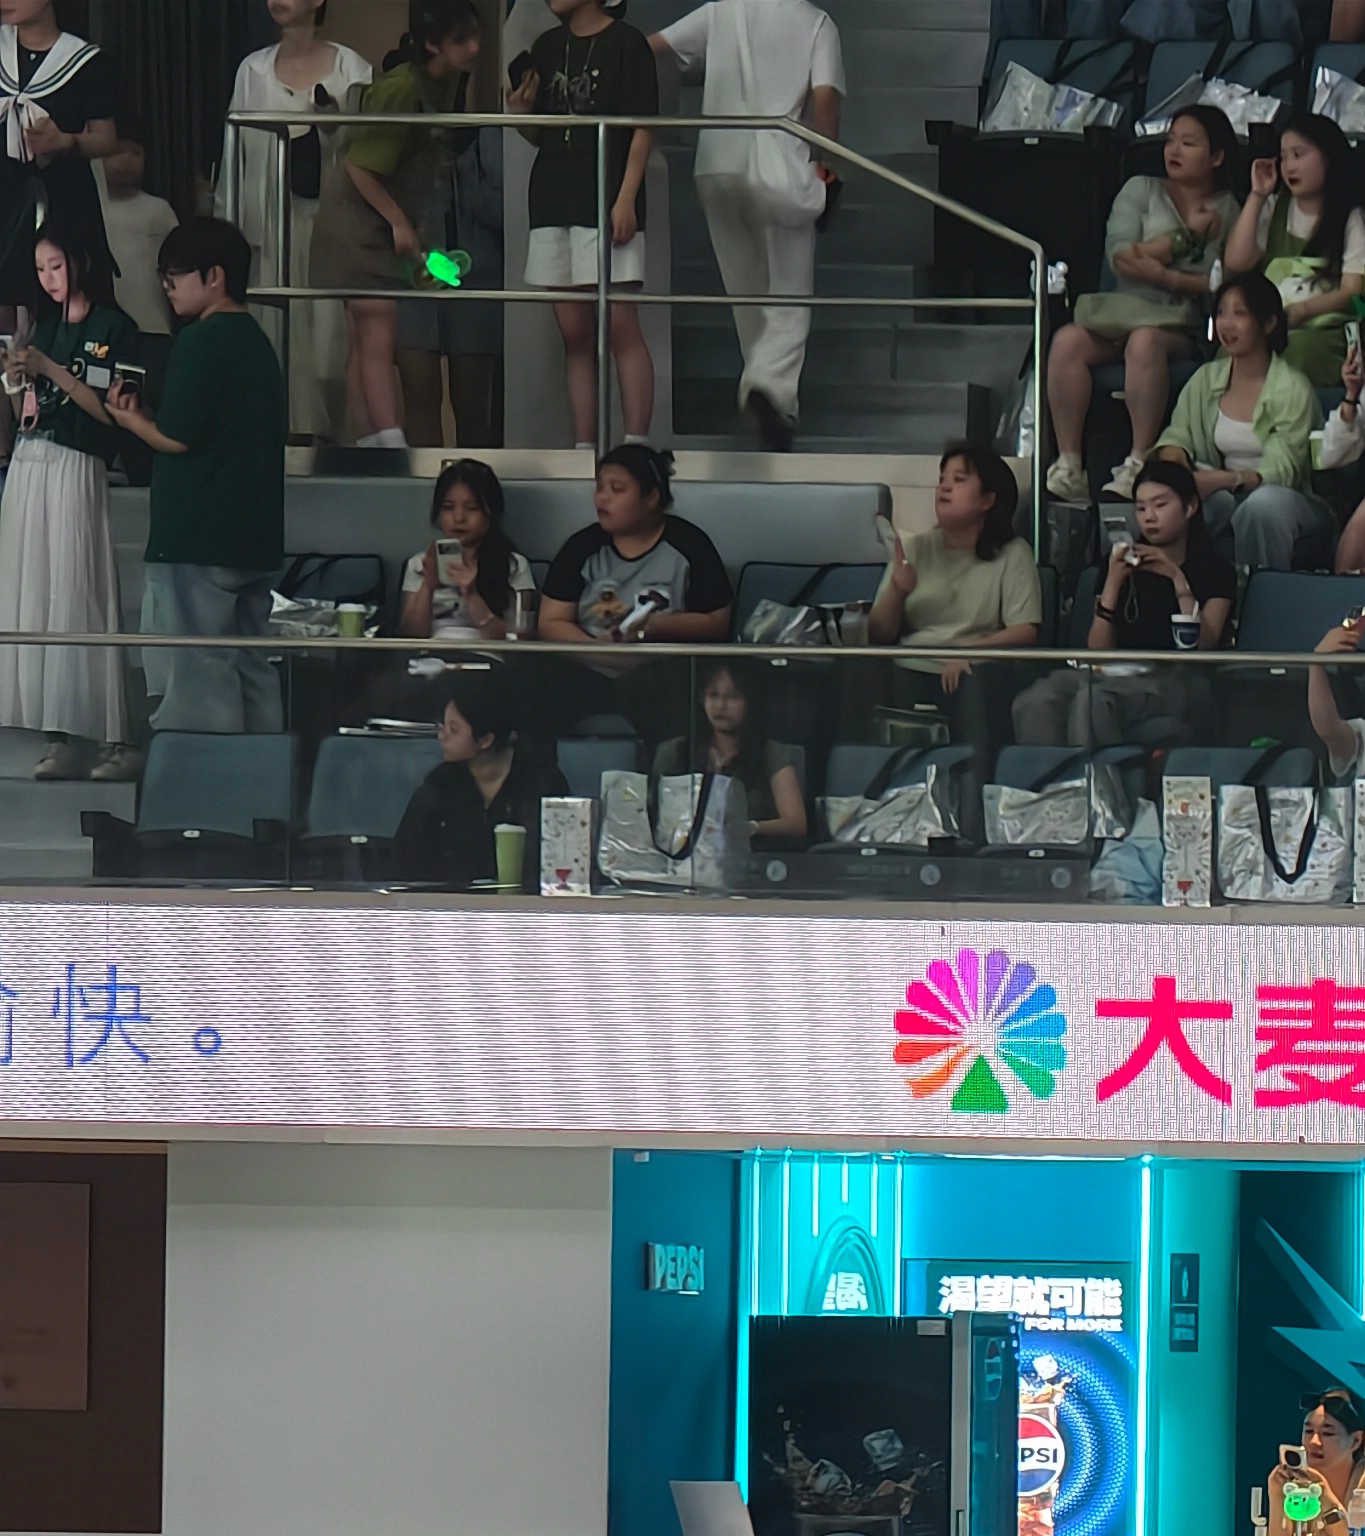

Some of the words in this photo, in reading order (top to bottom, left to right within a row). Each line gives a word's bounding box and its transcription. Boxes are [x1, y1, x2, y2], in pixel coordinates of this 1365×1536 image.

[938, 1275, 1123, 1316] 渴望就可能
[1020, 1447, 1058, 1464] PSI
